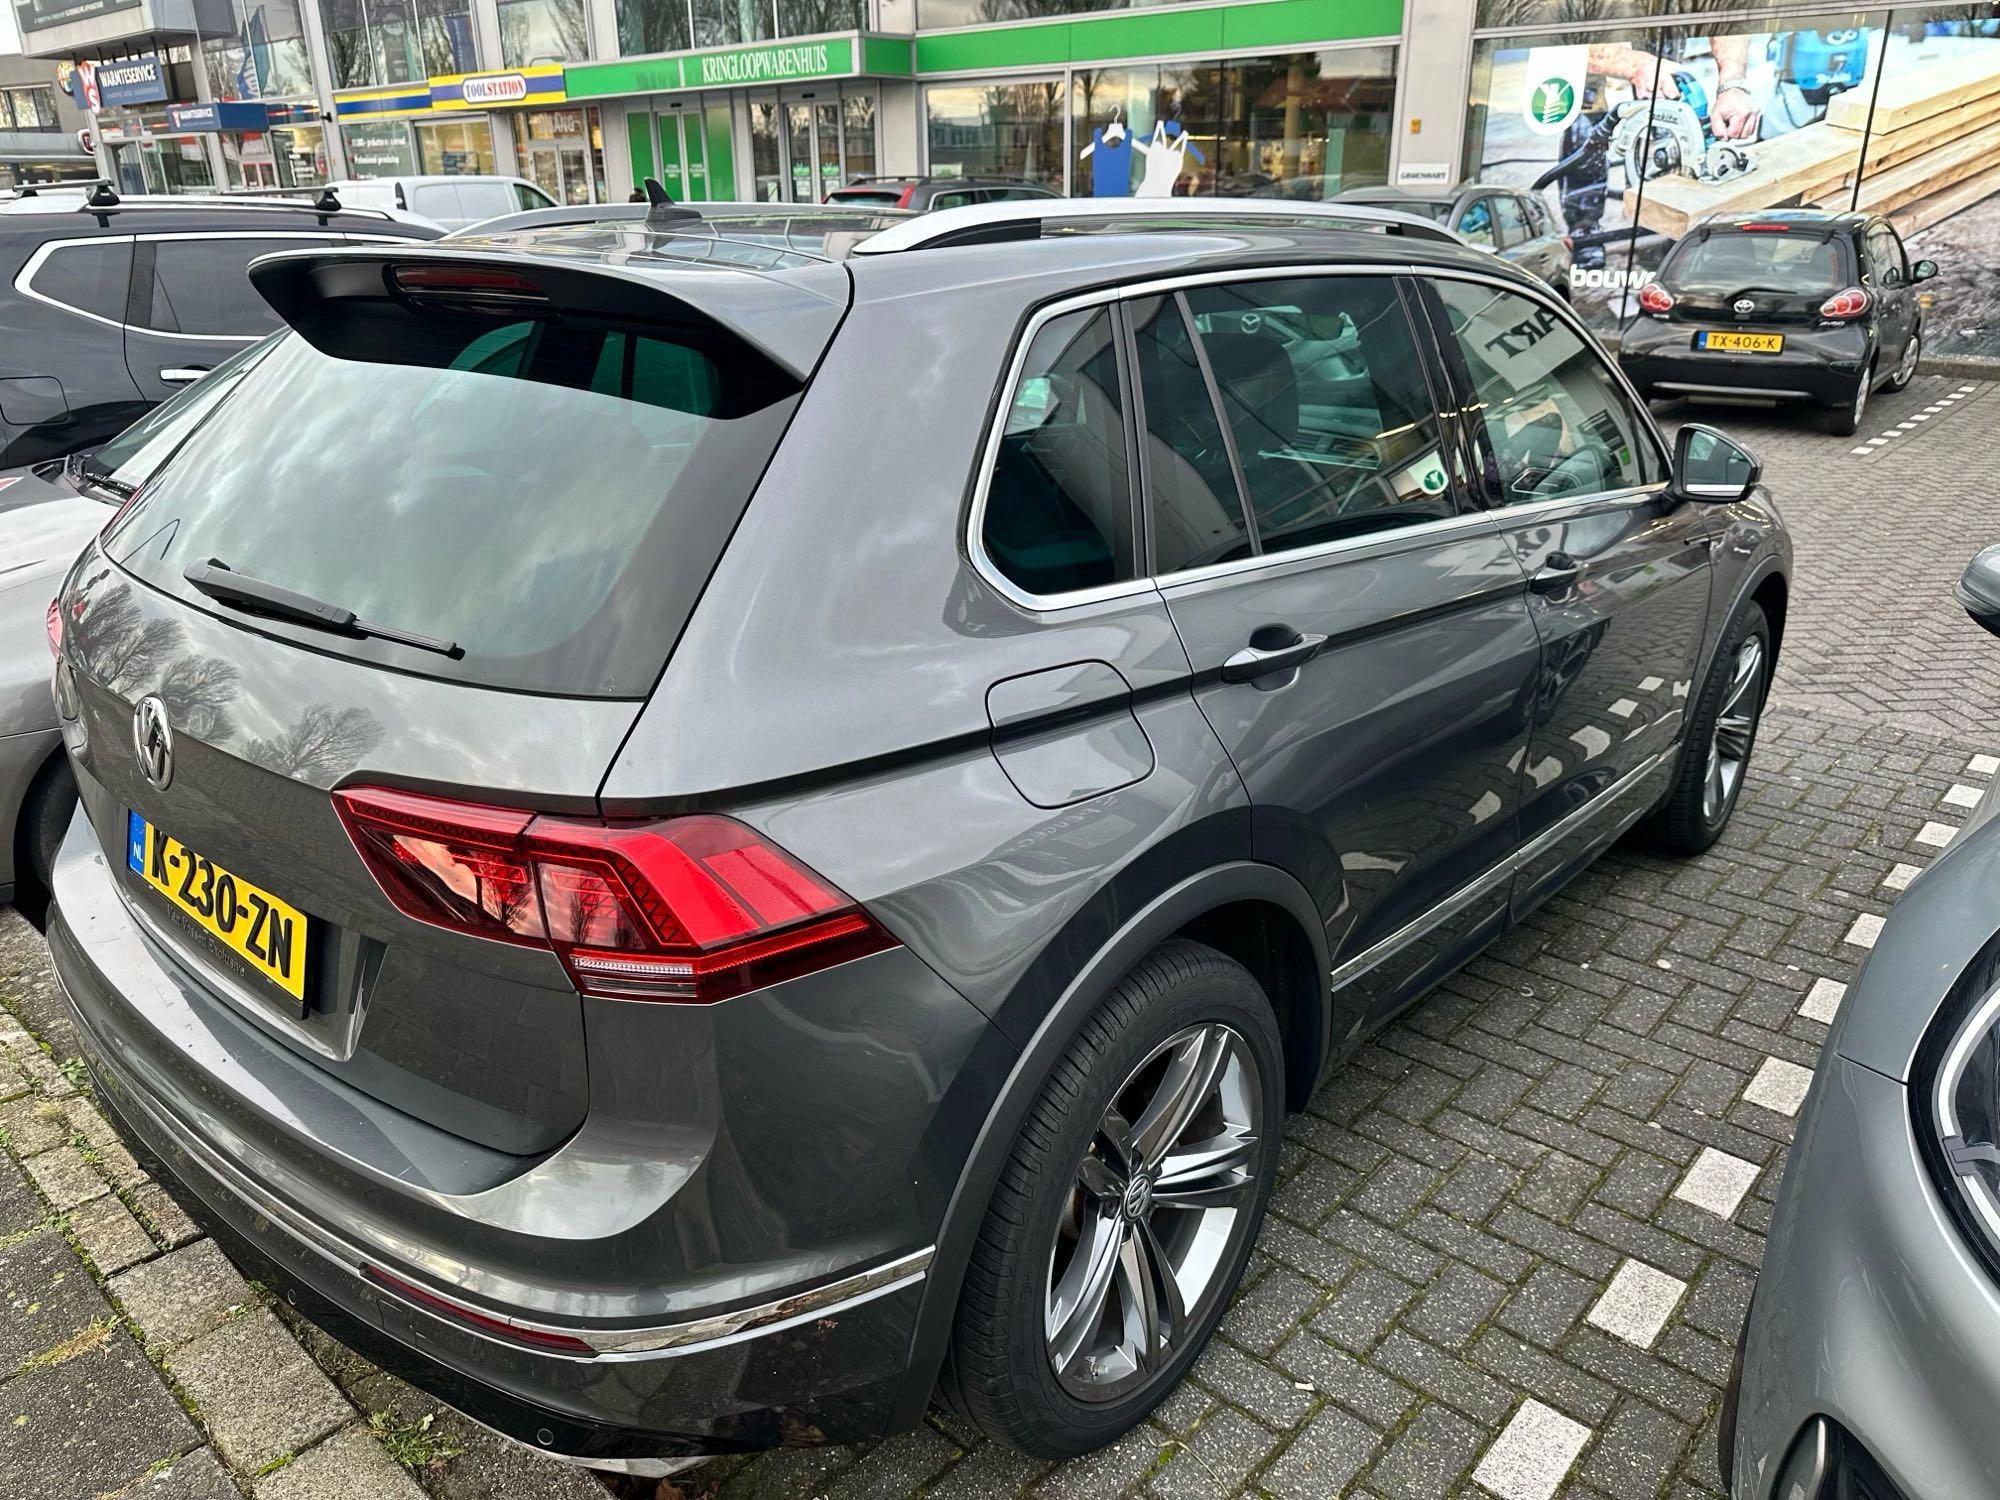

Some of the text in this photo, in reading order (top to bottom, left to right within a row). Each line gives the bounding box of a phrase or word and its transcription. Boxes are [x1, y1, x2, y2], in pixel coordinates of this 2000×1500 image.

[702, 45, 828, 83] KRINGLOOPWARENHUIS
[465, 78, 525, 98] TOOLSTATION
[1711, 335, 1776, 349] TX-406-K
[133, 841, 144, 863] NL
[151, 828, 293, 979] K-230-ZN
